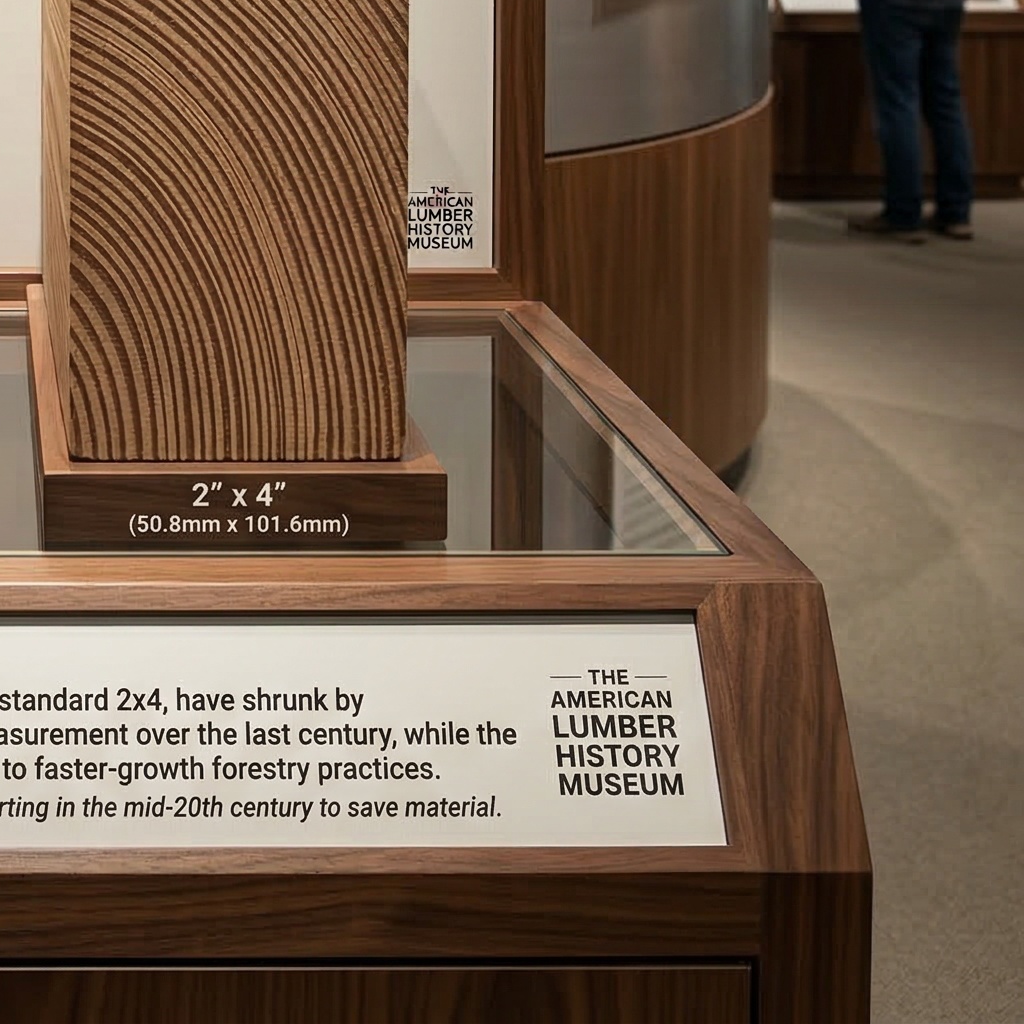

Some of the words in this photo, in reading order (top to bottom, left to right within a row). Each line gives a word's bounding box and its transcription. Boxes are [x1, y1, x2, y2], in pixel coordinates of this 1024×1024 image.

[409, 209, 473, 222] LUMBER
[408, 223, 473, 235] HISTORY
[408, 237, 472, 249] MUSEUM
[232, 489, 247, 506] x
[130, 514, 220, 537] (50.8mm
[227, 520, 237, 532] x
[245, 514, 348, 536] 101.6mm)
[588, 670, 629, 685] THE
[117, 688, 167, 715] 2x4,
[177, 687, 234, 711] have
[243, 687, 328, 711] shrunk
[336, 687, 364, 715] by
[551, 691, 672, 708] AMERICAN
[137, 728, 190, 745] over
[197, 721, 237, 745] the
[246, 721, 290, 745] last
[299, 724, 396, 750] century,
[404, 721, 469, 745] while
[476, 721, 516, 745] the
[553, 715, 677, 738] LUMBER
[556, 744, 679, 767] HISTORY
[2, 759, 26, 780] to
[35, 755, 203, 784] faster-growth
[212, 755, 310, 784] forestry
[319, 757, 440, 784] practices.
[559, 773, 684, 796] MUSEUM
[56, 797, 75, 817] in
[83, 796, 117, 817] the
[124, 796, 222, 817] mid-20th
[231, 798, 313, 822] century
[320, 798, 340, 817] to
[348, 801, 398, 817] save
[405, 796, 501, 817] material.
